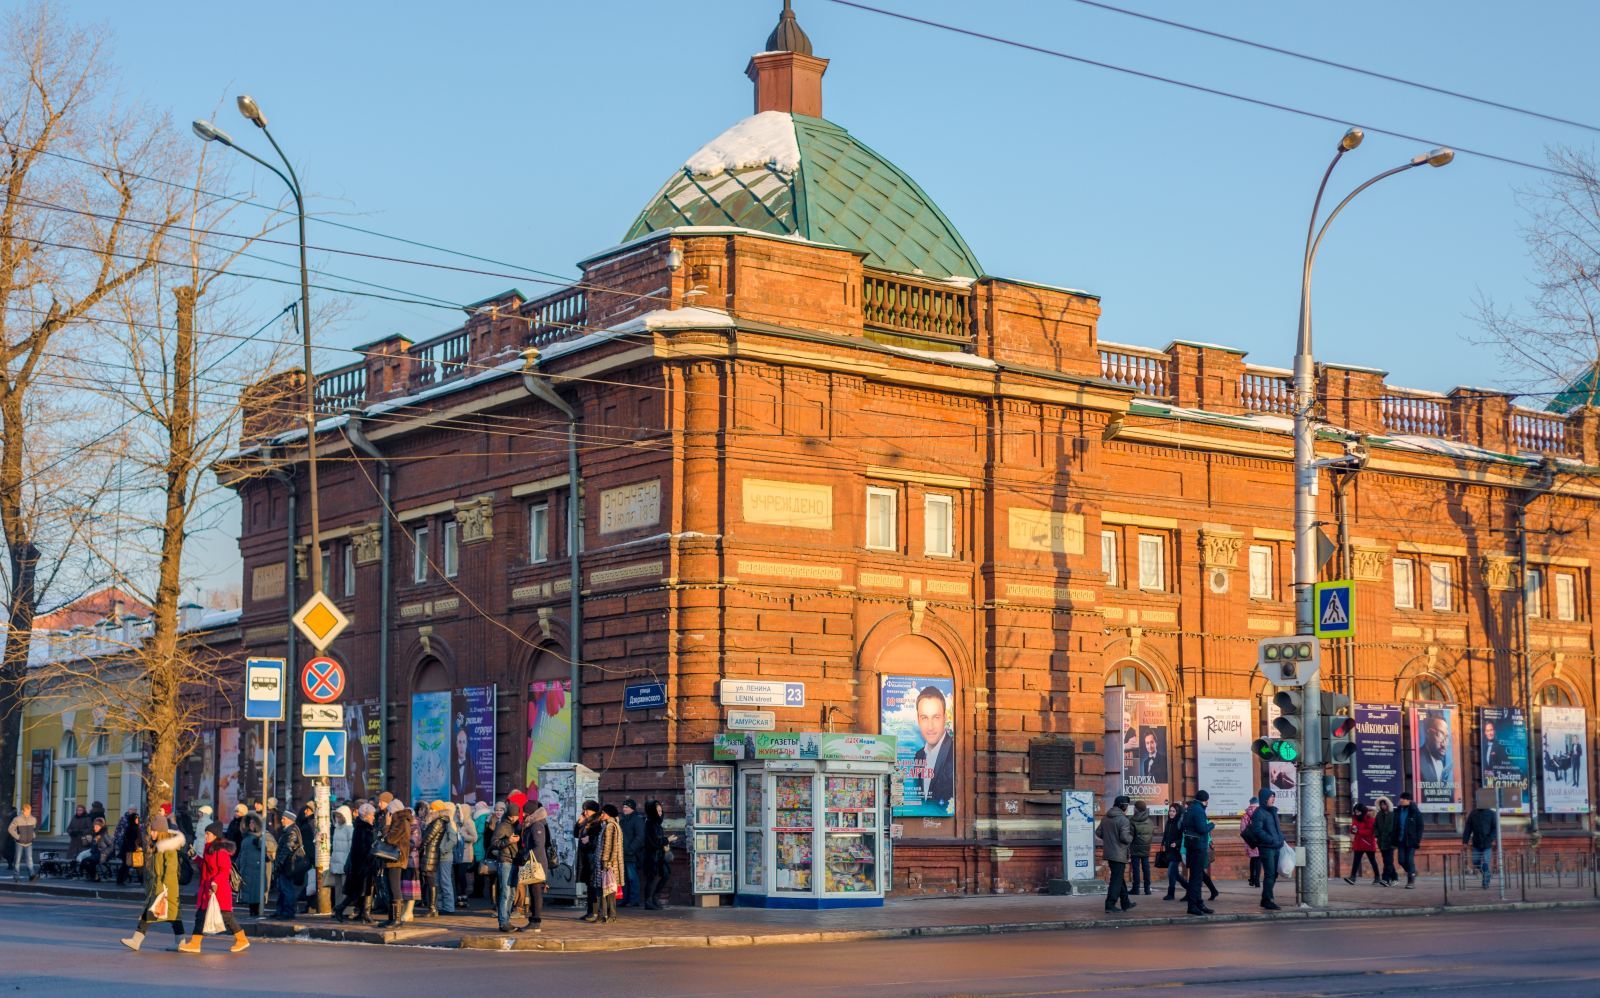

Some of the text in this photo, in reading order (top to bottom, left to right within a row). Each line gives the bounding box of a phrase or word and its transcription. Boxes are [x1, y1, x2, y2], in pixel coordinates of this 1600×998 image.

[751, 493, 824, 515] УЧРЕЖДЕНО
[787, 688, 802, 701] 23
[1203, 715, 1243, 741] REQUIEM
[1355, 722, 1399, 734] ЧАЙКОВСКИЙ
[770, 738, 798, 746] ГАЗЕТЫ
[758, 748, 796, 756] ЖУРНАЛЫ
[1129, 775, 1157, 785] ПАРИЖА
